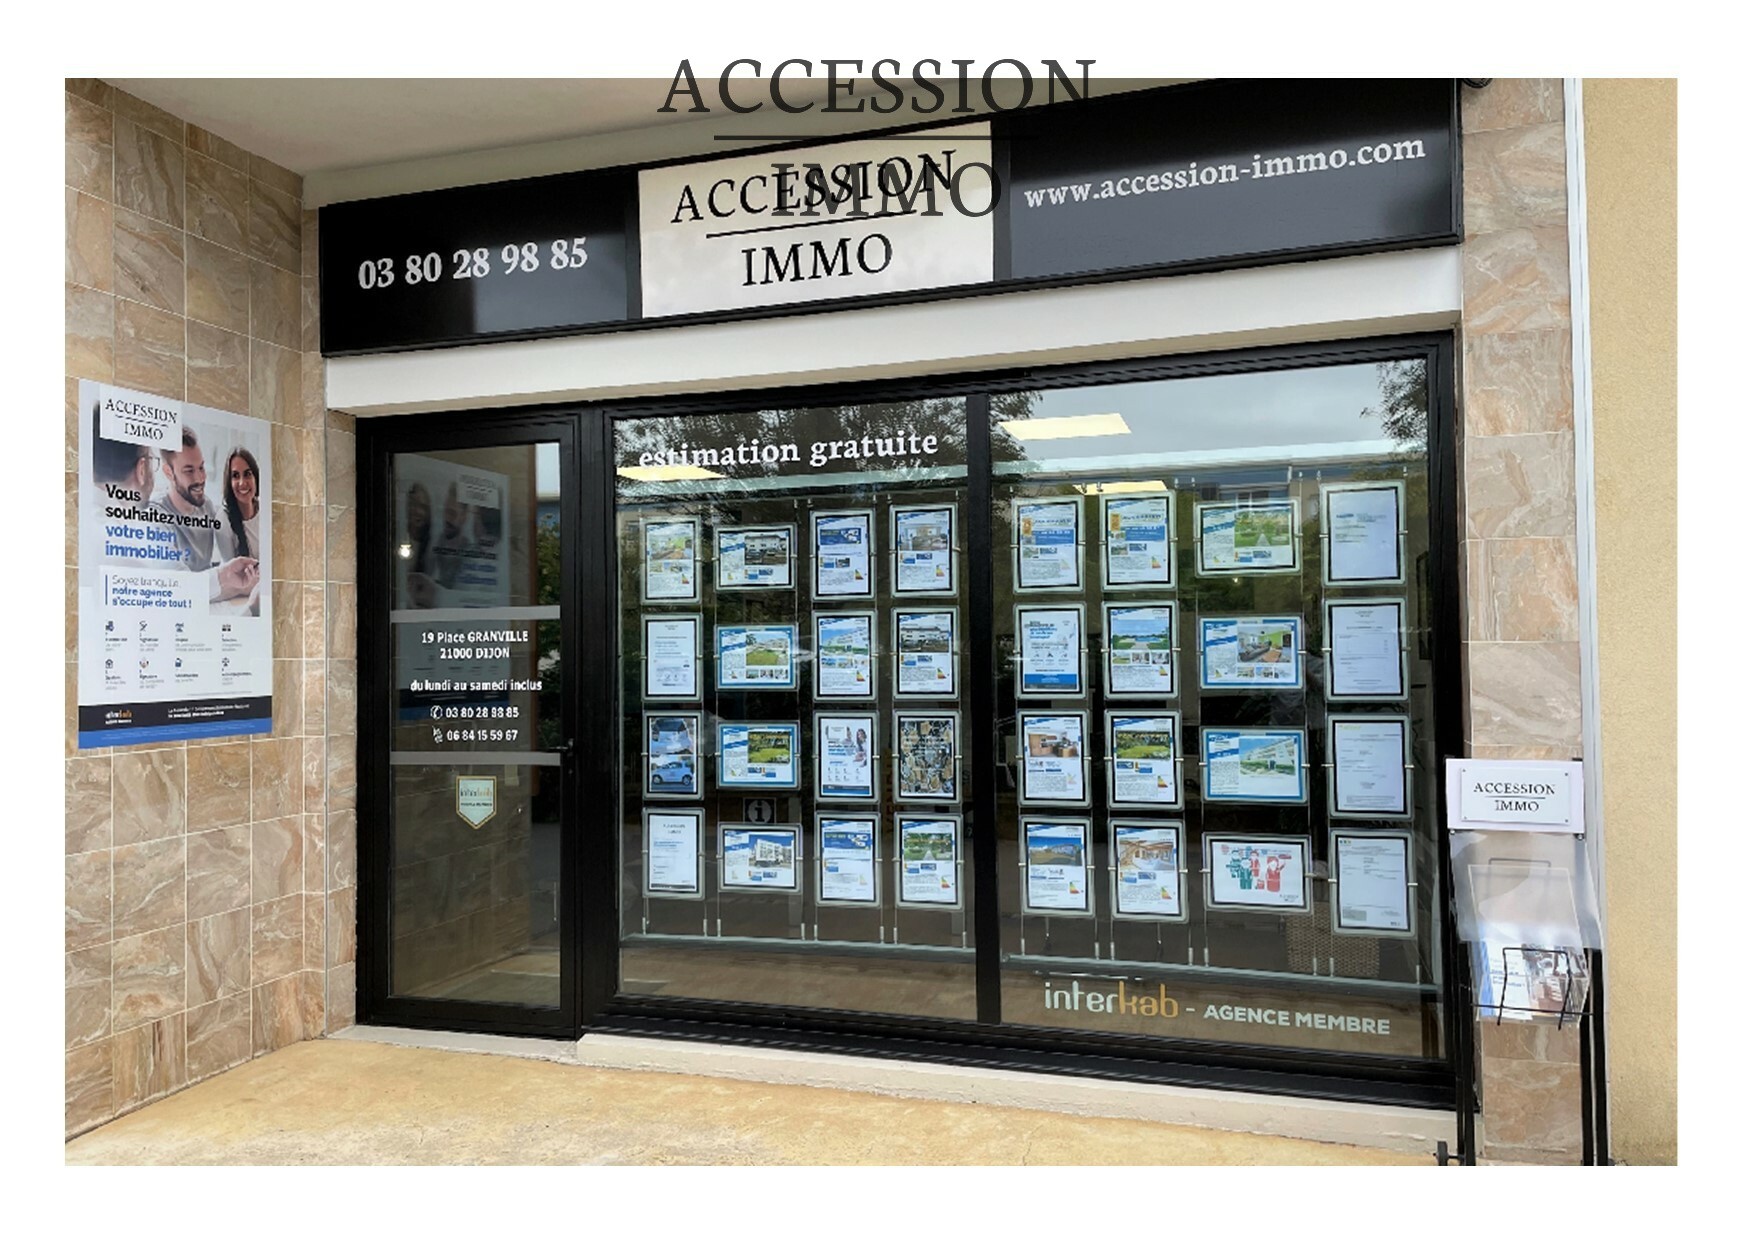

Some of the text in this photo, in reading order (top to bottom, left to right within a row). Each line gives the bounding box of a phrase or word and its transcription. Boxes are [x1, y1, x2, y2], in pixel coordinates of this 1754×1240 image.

[1024, 138, 1426, 208] www.accession-immo.com
[671, 150, 956, 224] ACCESSION
[358, 237, 587, 289] 03 80 28 98 85
[742, 233, 893, 287] IMMO
[105, 398, 177, 424] ACCESSION
[124, 423, 164, 441] IMMO
[639, 430, 938, 468] estimation gratuite
[105, 484, 142, 502] Vous
[105, 505, 221, 530] souhaitez vendre
[105, 525, 177, 542] votre bien
[105, 541, 191, 562] immobilier ?
[112, 587, 173, 599] notre agence
[155, 599, 167, 607] de
[169, 599, 187, 608] tout
[421, 631, 528, 644] 19 Place GRANVILLE
[440, 647, 510, 659] 21000 DIJON
[410, 679, 542, 691] du lundi au samedi inclus
[446, 707, 458, 718] 03
[461, 707, 474, 718] 80
[476, 706, 488, 718] 28
[506, 706, 519, 718] 85
[447, 729, 518, 741] 06 84 15 59 67
[1473, 782, 1556, 796] ACCESSION
[1494, 800, 1539, 813] IMMO
[1044, 980, 1179, 1018] interkab
[1203, 1004, 1290, 1027] AGENCE
[1295, 1011, 1391, 1035] MEMBRE
